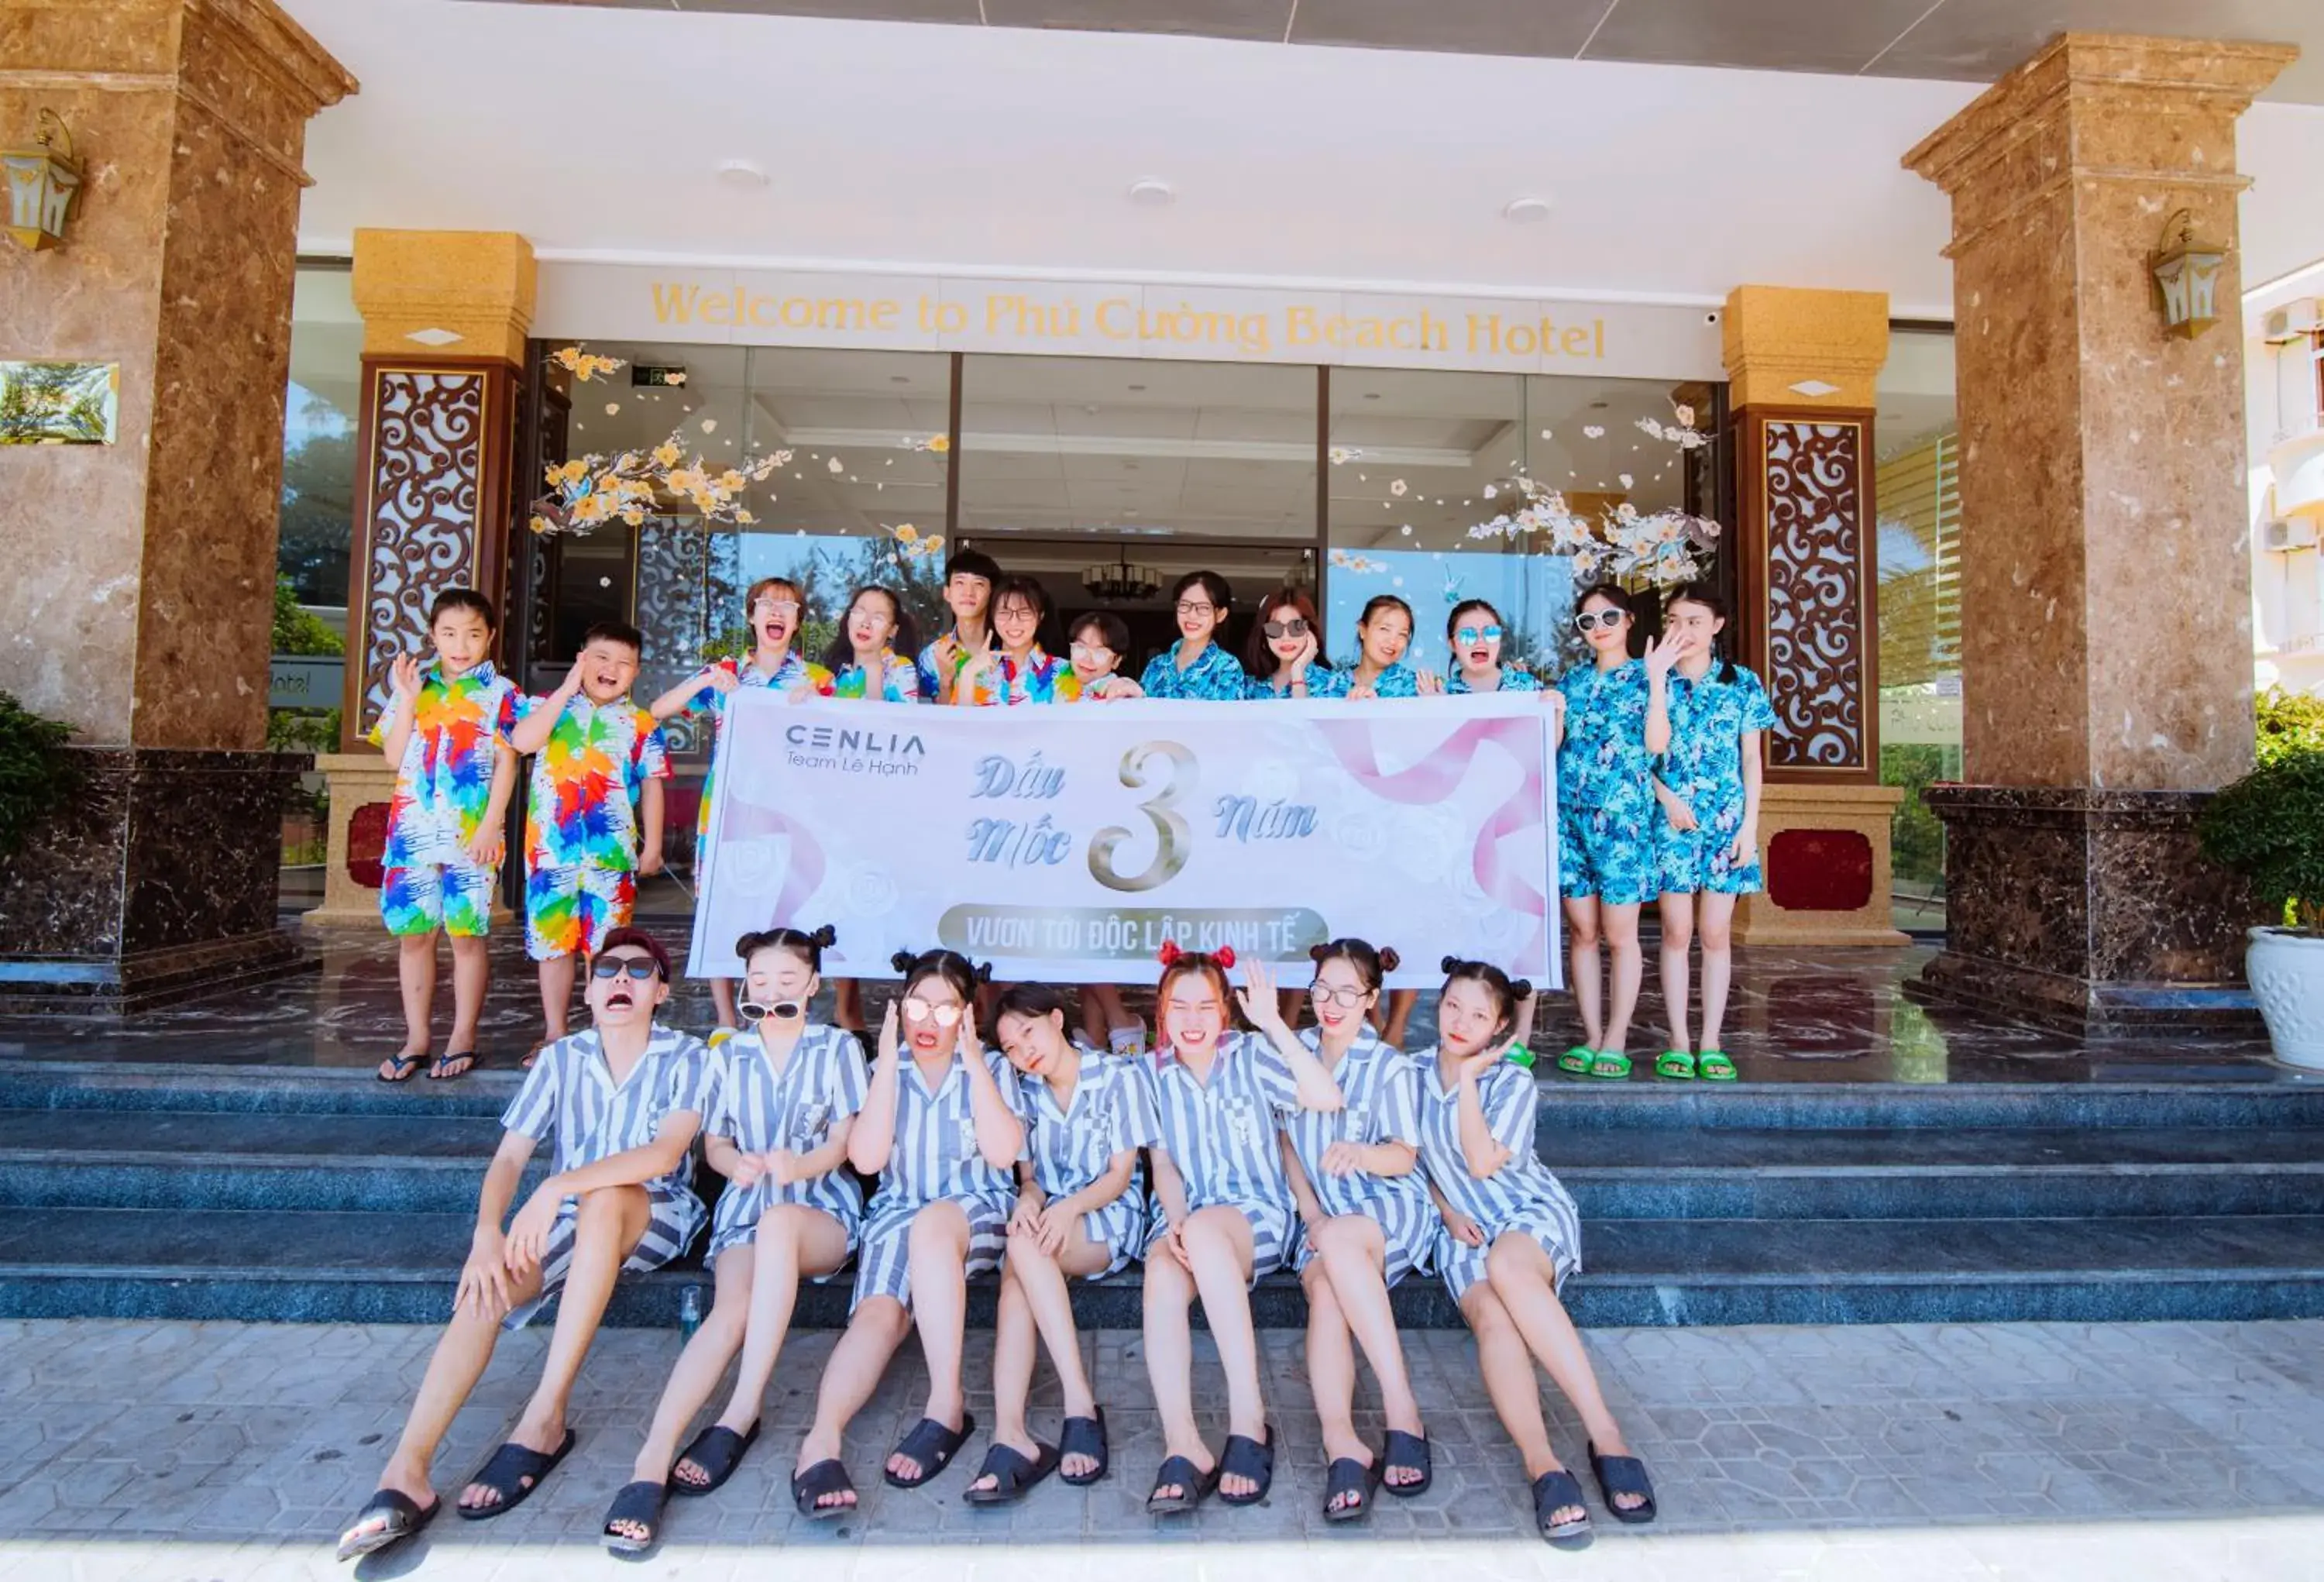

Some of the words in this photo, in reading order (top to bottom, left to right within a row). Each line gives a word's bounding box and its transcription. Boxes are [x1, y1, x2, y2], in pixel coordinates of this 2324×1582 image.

[651, 282, 901, 331] Welcome
[917, 293, 969, 335] to
[1286, 306, 1449, 352] Beach
[1465, 312, 1605, 360] Hotel
[787, 751, 837, 769] Team
[842, 757, 864, 772] Lê
[868, 758, 919, 777] Hạnh
[966, 813, 1072, 870] Mốc
[1087, 740, 1201, 892] 3
[1087, 913, 1138, 958] ĐỘC
[1198, 920, 1260, 951] KINH
[1266, 911, 1301, 952] TẾ
